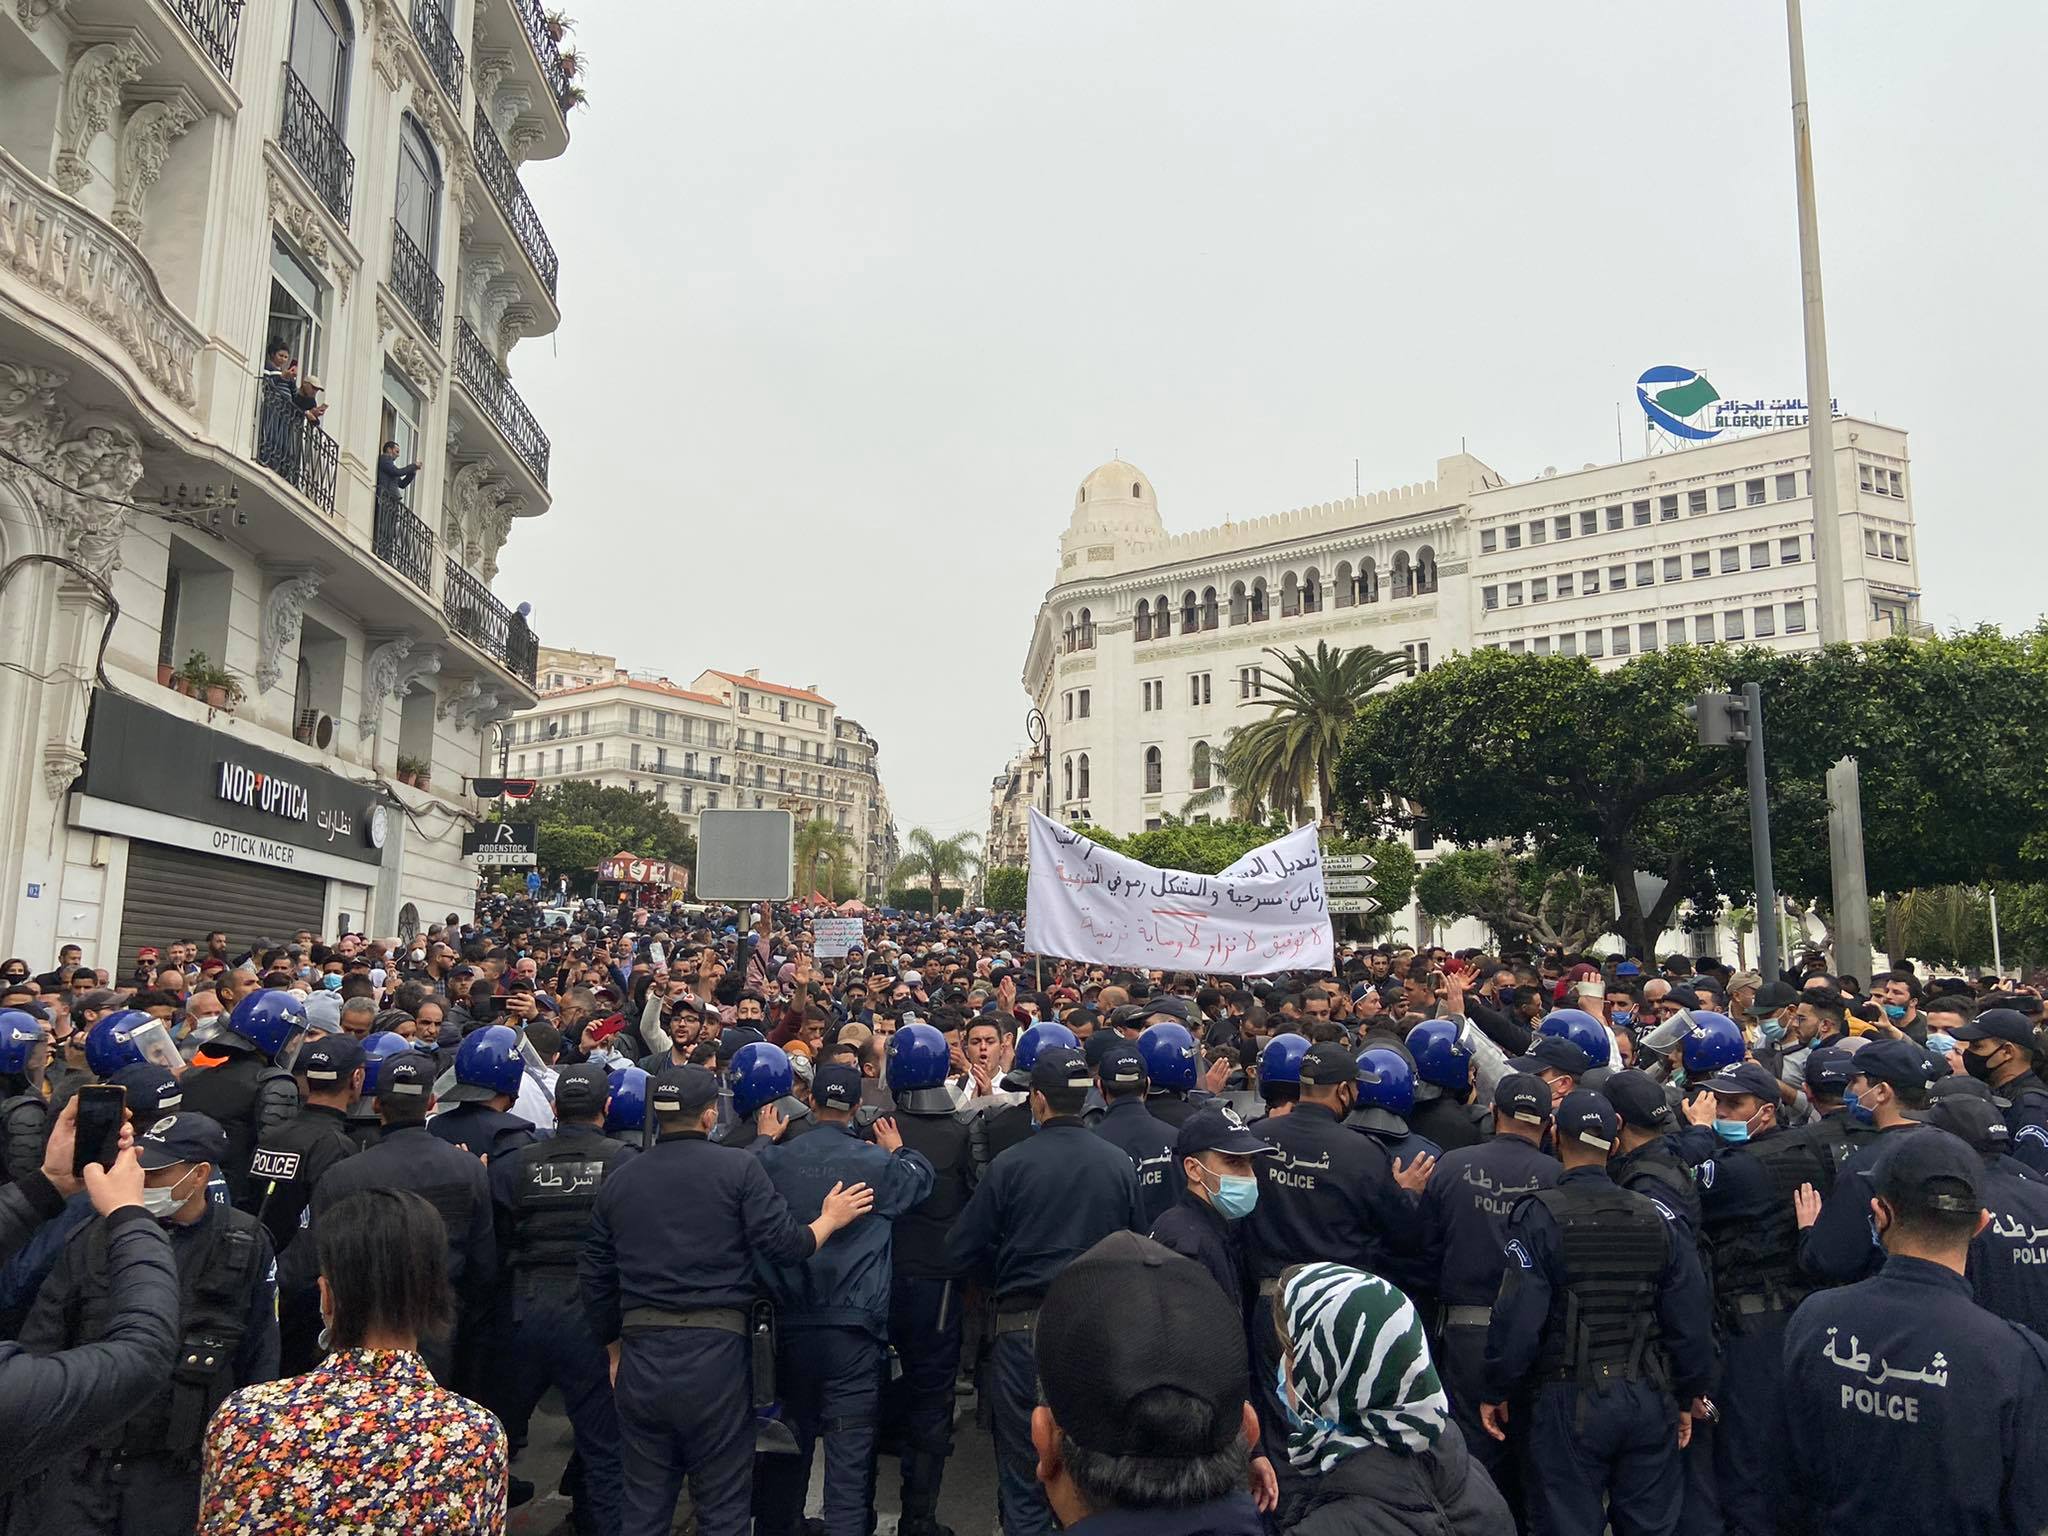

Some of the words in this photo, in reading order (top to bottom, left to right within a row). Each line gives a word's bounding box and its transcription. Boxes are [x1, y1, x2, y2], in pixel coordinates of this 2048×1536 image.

[1716, 400, 1764, 414] الجزائر
[317, 809, 352, 842] نظارات
[213, 831, 256, 856] OPTICK
[259, 841, 294, 864] NACER
[476, 854, 529, 864] OPTICK
[479, 844, 528, 853] RODENSTOCK
[1151, 872, 1207, 897] المشكل
[1227, 884, 1282, 912] مسرحية
[1263, 930, 1305, 959] توفيق
[254, 1153, 297, 1175] POLICE
[533, 1166, 593, 1193] شرطة
[1269, 1168, 1315, 1190] POLICE
[1463, 1164, 1539, 1197] شرطة
[1474, 1195, 1515, 1215] POLIC
[1989, 1212, 2048, 1244] رطة
[2013, 1246, 2046, 1265] POLI
[1823, 1327, 1948, 1388] شرطة
